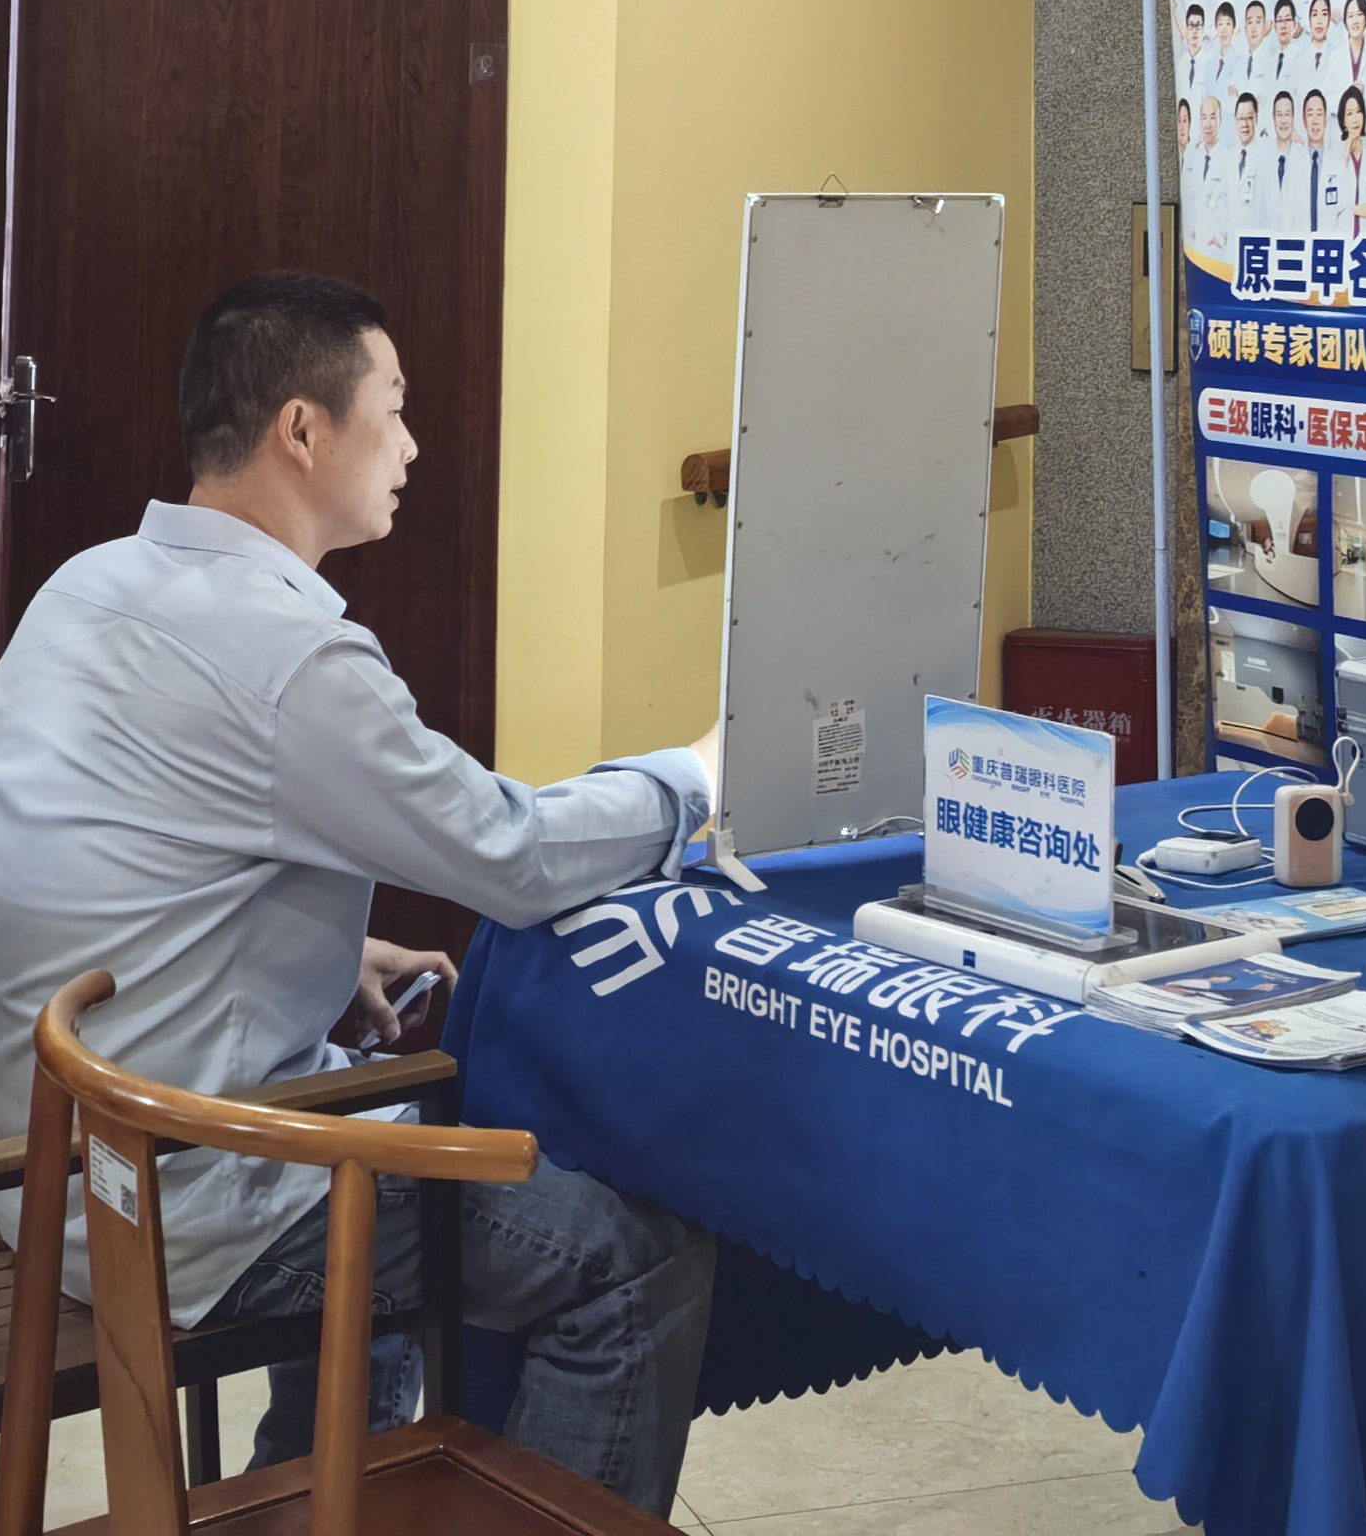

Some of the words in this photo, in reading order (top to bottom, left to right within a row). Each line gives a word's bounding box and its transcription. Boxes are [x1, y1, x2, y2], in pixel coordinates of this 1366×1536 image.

[972, 755, 1085, 798] 重庆普瑞眼科医院
[937, 796, 1101, 872] 眼健康咨询处
[704, 966, 800, 1029] BRIGHT
[810, 1005, 861, 1052] EYE
[870, 1024, 1013, 1107] HOSPITAL
[715, 913, 1082, 1053] 普瑞眼科
